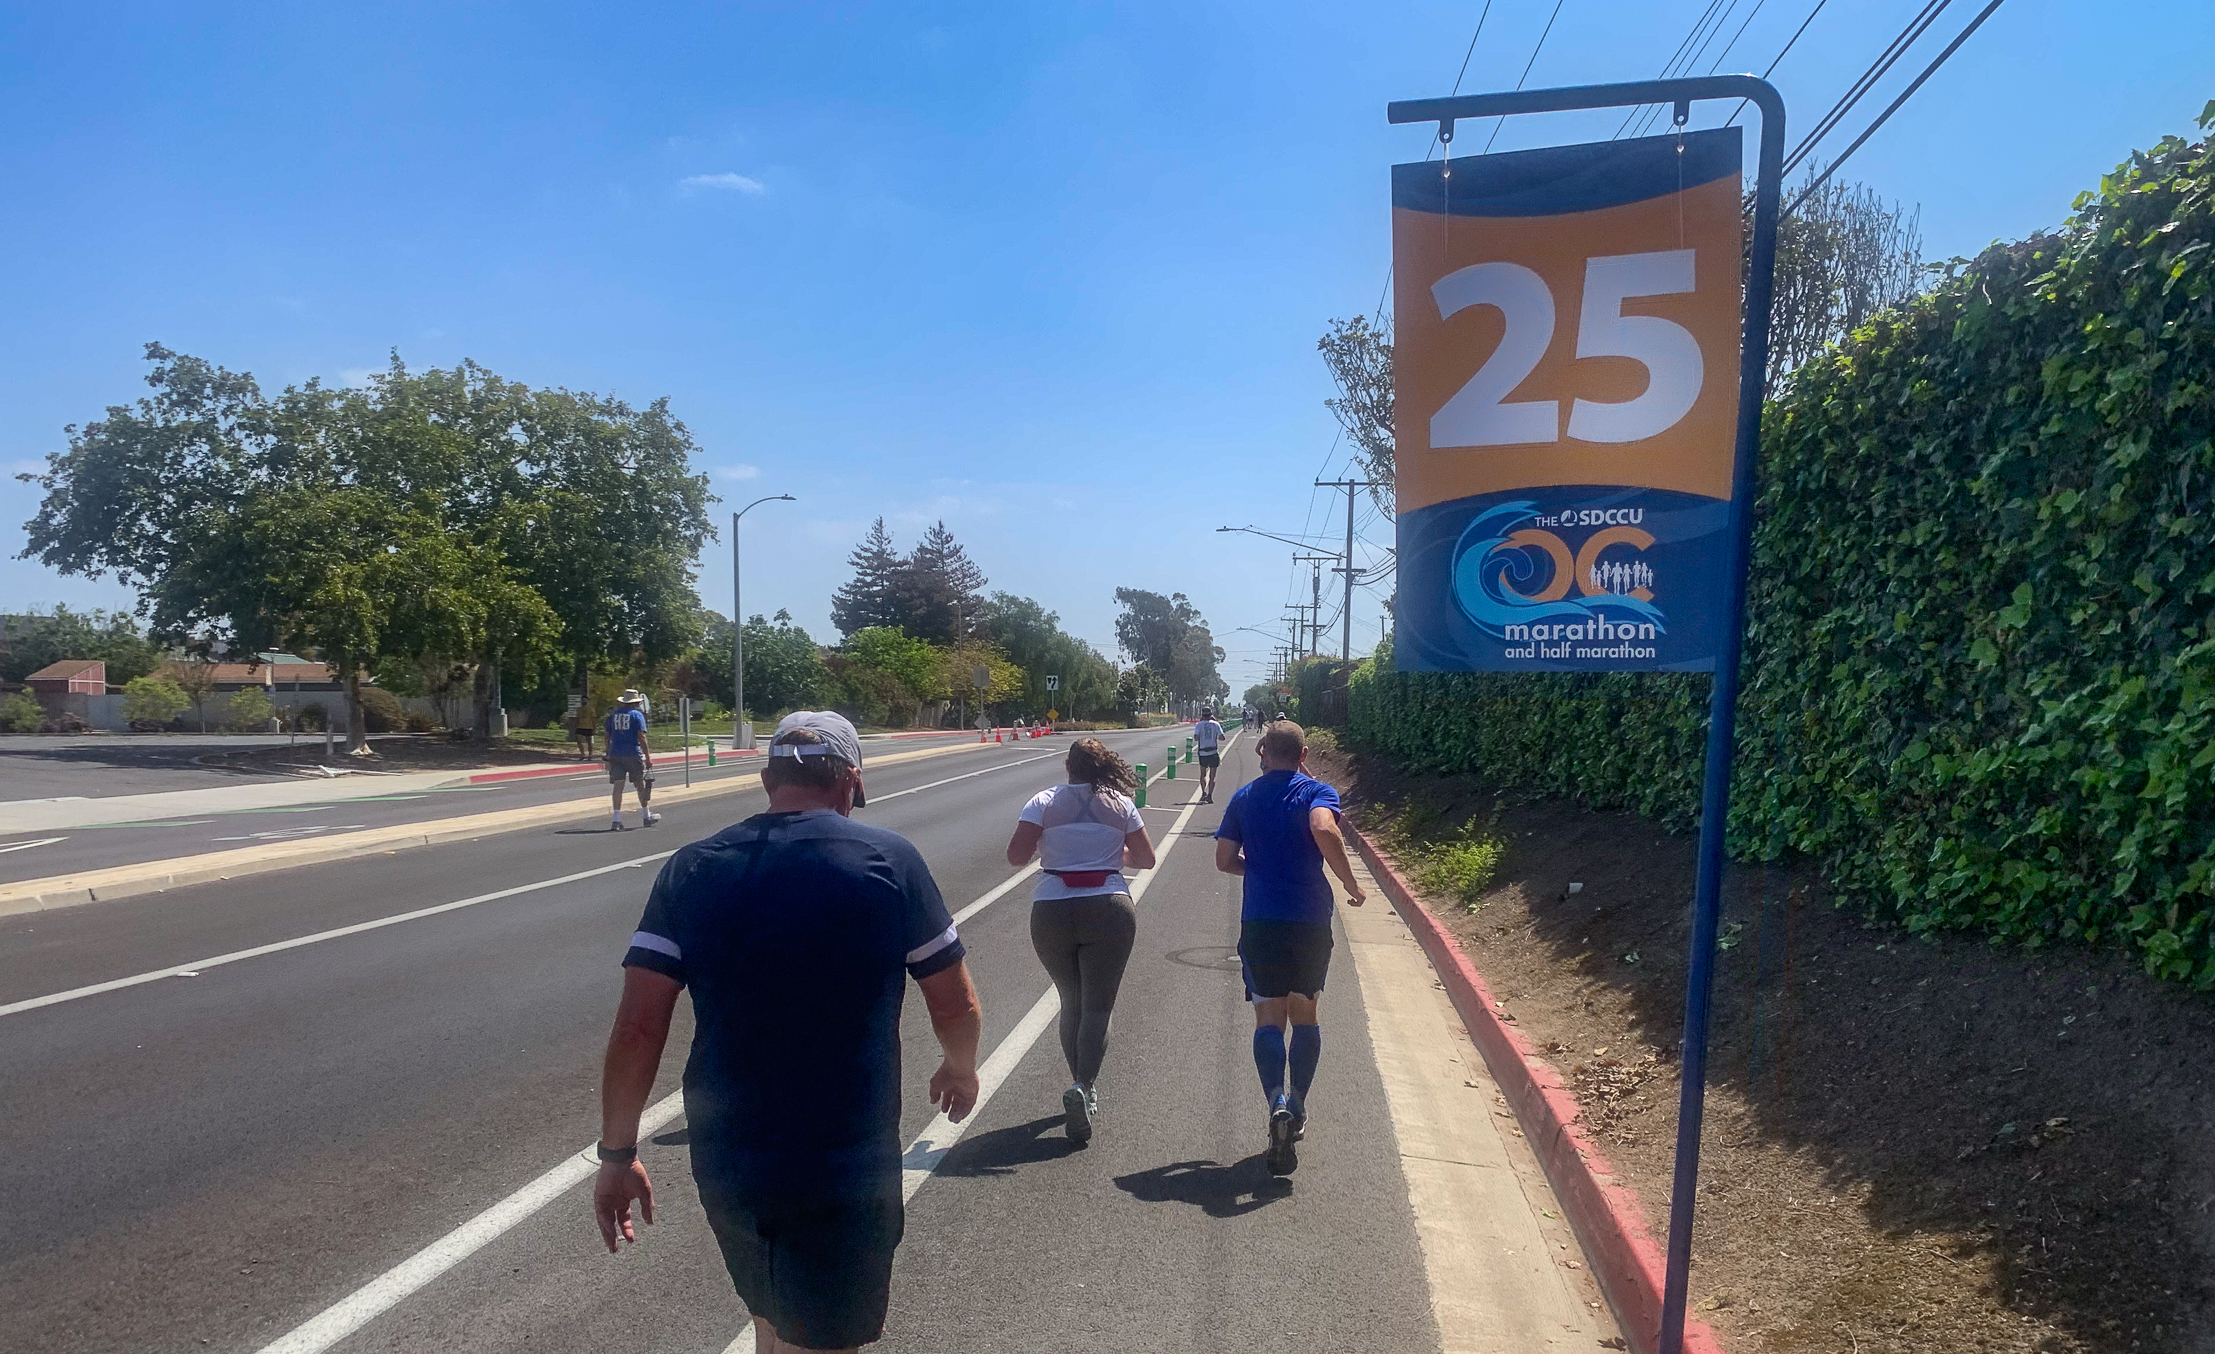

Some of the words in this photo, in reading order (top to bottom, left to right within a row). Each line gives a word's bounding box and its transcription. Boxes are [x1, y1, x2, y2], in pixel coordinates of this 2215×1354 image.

[1430, 248, 1704, 448] 25
[1534, 516, 1559, 527] THE
[1579, 508, 1643, 526] SDCCU
[1489, 526, 1656, 602] OC
[1505, 614, 1656, 640] marathon
[1504, 642, 1535, 659] and
[1541, 641, 1572, 659] half
[1576, 642, 1656, 659] marathon
